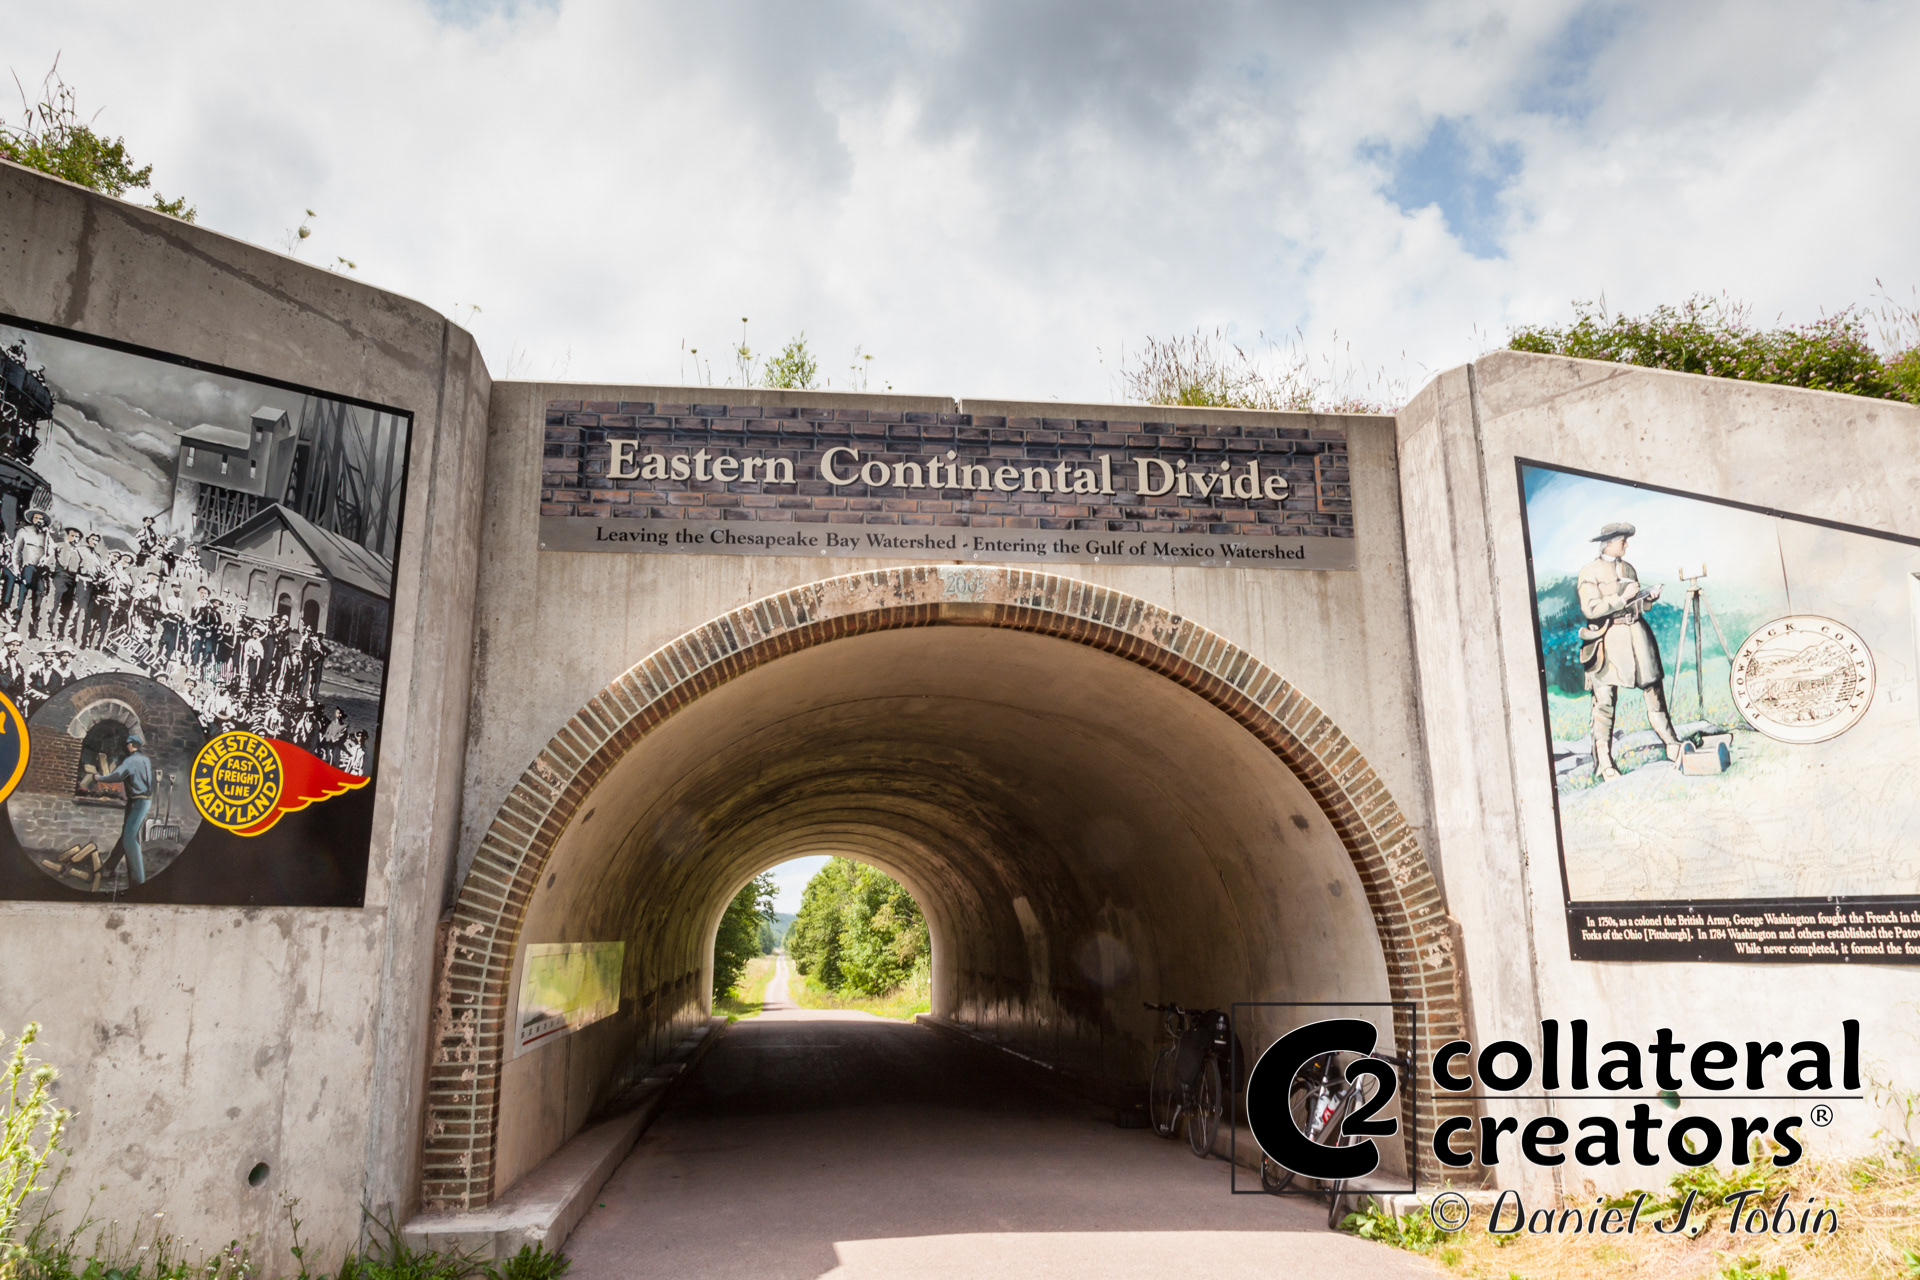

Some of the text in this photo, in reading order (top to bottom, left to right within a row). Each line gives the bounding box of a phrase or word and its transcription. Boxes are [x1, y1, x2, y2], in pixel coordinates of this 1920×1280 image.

[606, 438, 1290, 501] Eastern Continental Divide
[595, 527, 669, 546] Leaving
[675, 528, 705, 545] the
[709, 529, 819, 549] Chesapeake
[825, 534, 860, 552] Bay
[865, 533, 957, 550] Watershed
[972, 536, 1047, 556] Entering
[1052, 539, 1080, 555] the
[1085, 540, 1125, 557] Gulf
[1129, 541, 1148, 556] of
[1153, 542, 1215, 559] Mexico
[1219, 543, 1305, 560] Watershed
[1736, 623, 1866, 719] PATOWMACK COMPANY
[201, 736, 276, 773] WESTERN
[227, 758, 253, 772] FAST
[218, 770, 260, 785] FREIGHT
[224, 784, 250, 797] LINE
[196, 778, 277, 823] MARYLAND
[1586, 916, 1595, 927] In
[1598, 916, 1618, 928] 1750s,
[1619, 918, 1627, 926] as
[1628, 918, 1633, 926] a
[1634, 914, 1662, 926] colonel
[1663, 914, 1676, 926] the
[1677, 914, 1704, 926] British
[1707, 914, 1732, 927] Army,
[1733, 913, 1763, 927] George
[1764, 912, 1816, 927] Washington
[1818, 911, 1847, 926] fought
[1849, 911, 1864, 923] the
[1865, 910, 1898, 923] French
[1899, 911, 1910, 923] in
[1581, 929, 1602, 940] Forks
[1603, 929, 1611, 940] of
[1611, 929, 1623, 940] the
[1623, 929, 1642, 940] Ohio
[1697, 928, 1707, 939] In
[1709, 929, 1726, 939] 1784
[1727, 928, 1777, 941] Washington
[1779, 927, 1795, 939] and
[1797, 927, 1825, 939] others
[1827, 926, 1877, 939] established
[1878, 926, 1894, 939] the
[1734, 942, 1761, 954] While
[1763, 945, 1787, 954] never
[1789, 942, 1839, 956] completed,
[1841, 942, 1849, 954] it
[1851, 942, 1885, 954] formed
[1886, 942, 1902, 954] the
